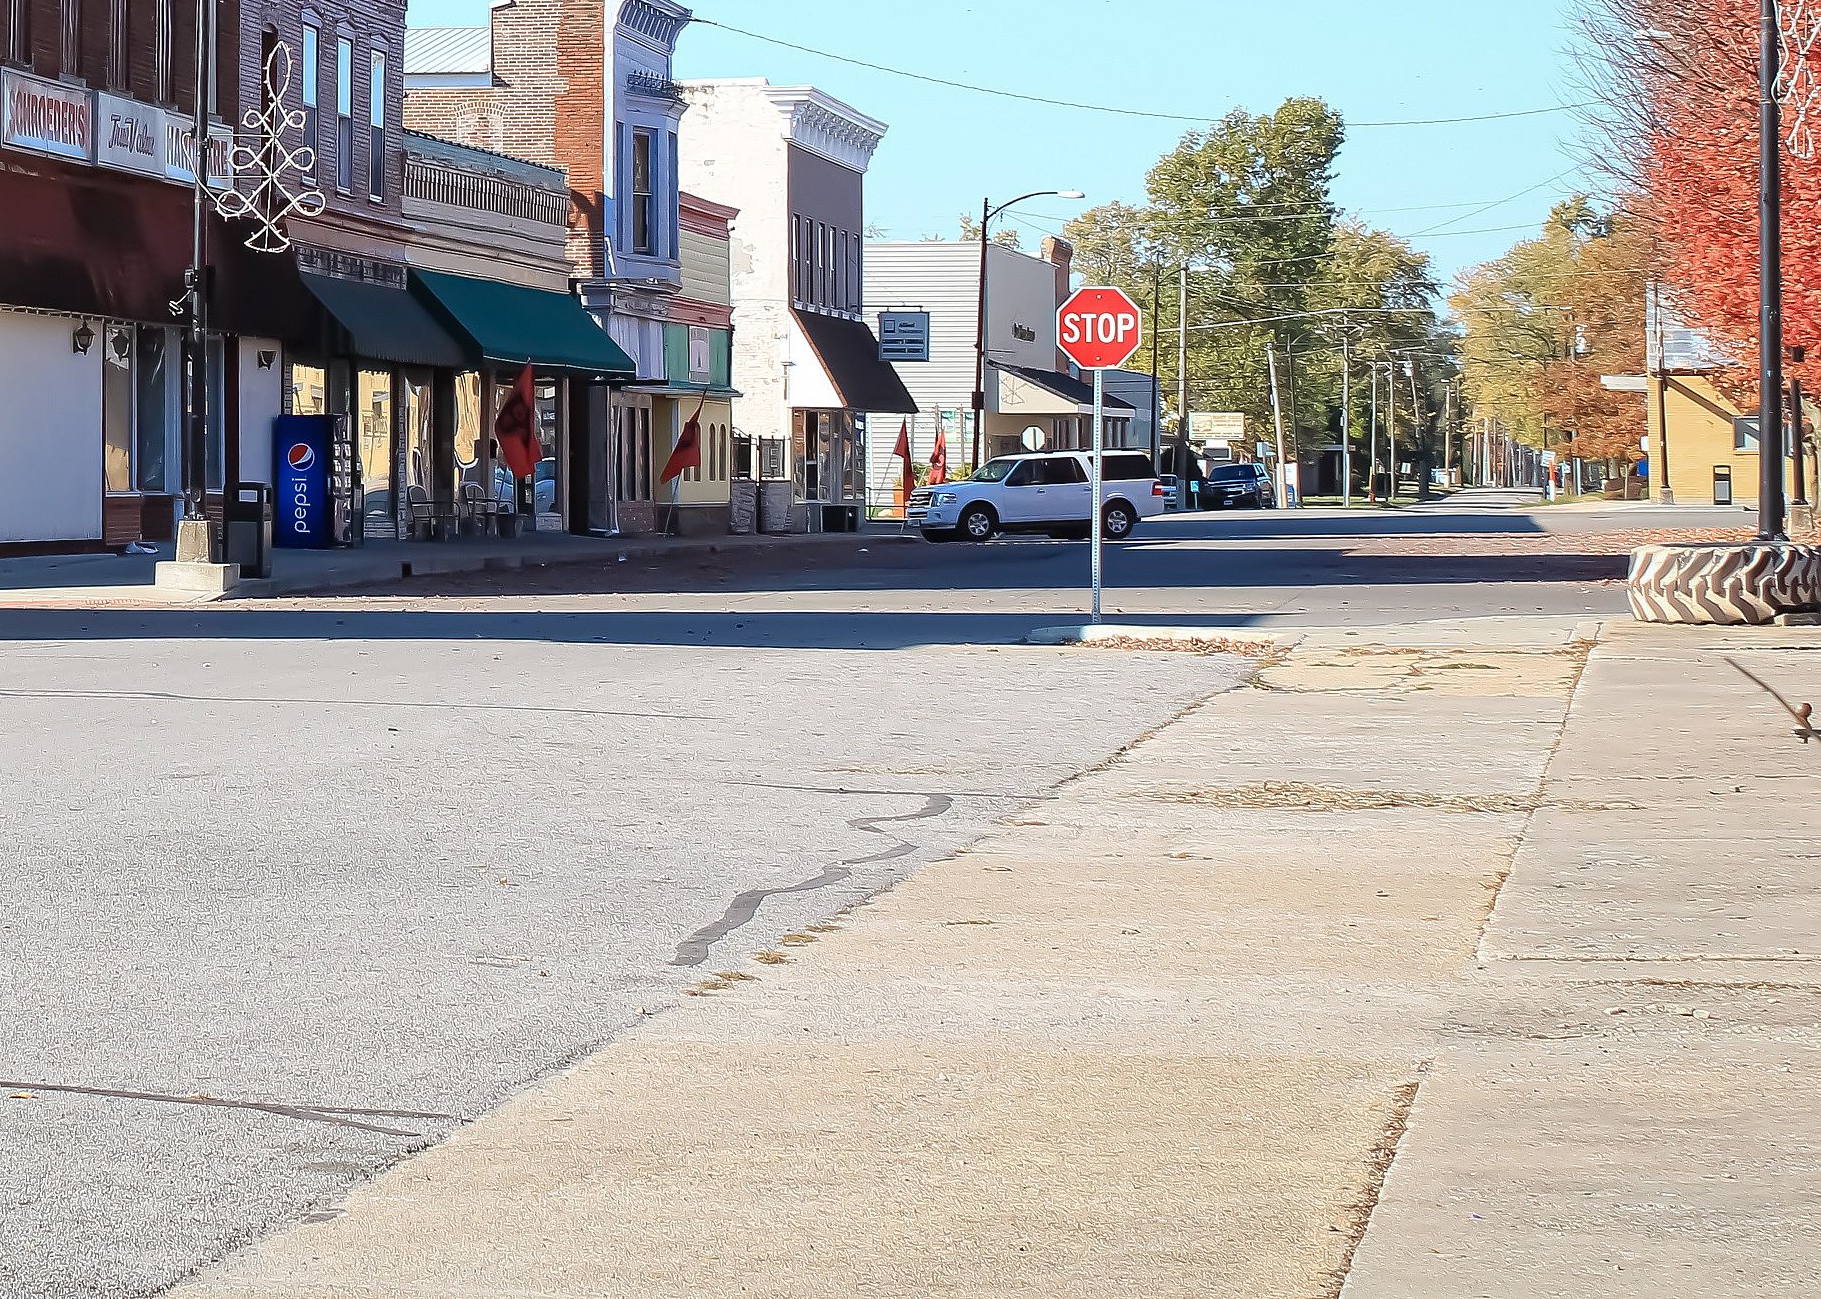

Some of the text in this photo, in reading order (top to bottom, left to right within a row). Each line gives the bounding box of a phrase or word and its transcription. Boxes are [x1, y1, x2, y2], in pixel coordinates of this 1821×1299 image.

[108, 113, 129, 149] True
[1062, 312, 1135, 343] STOP
[291, 477, 311, 533] pepsi
